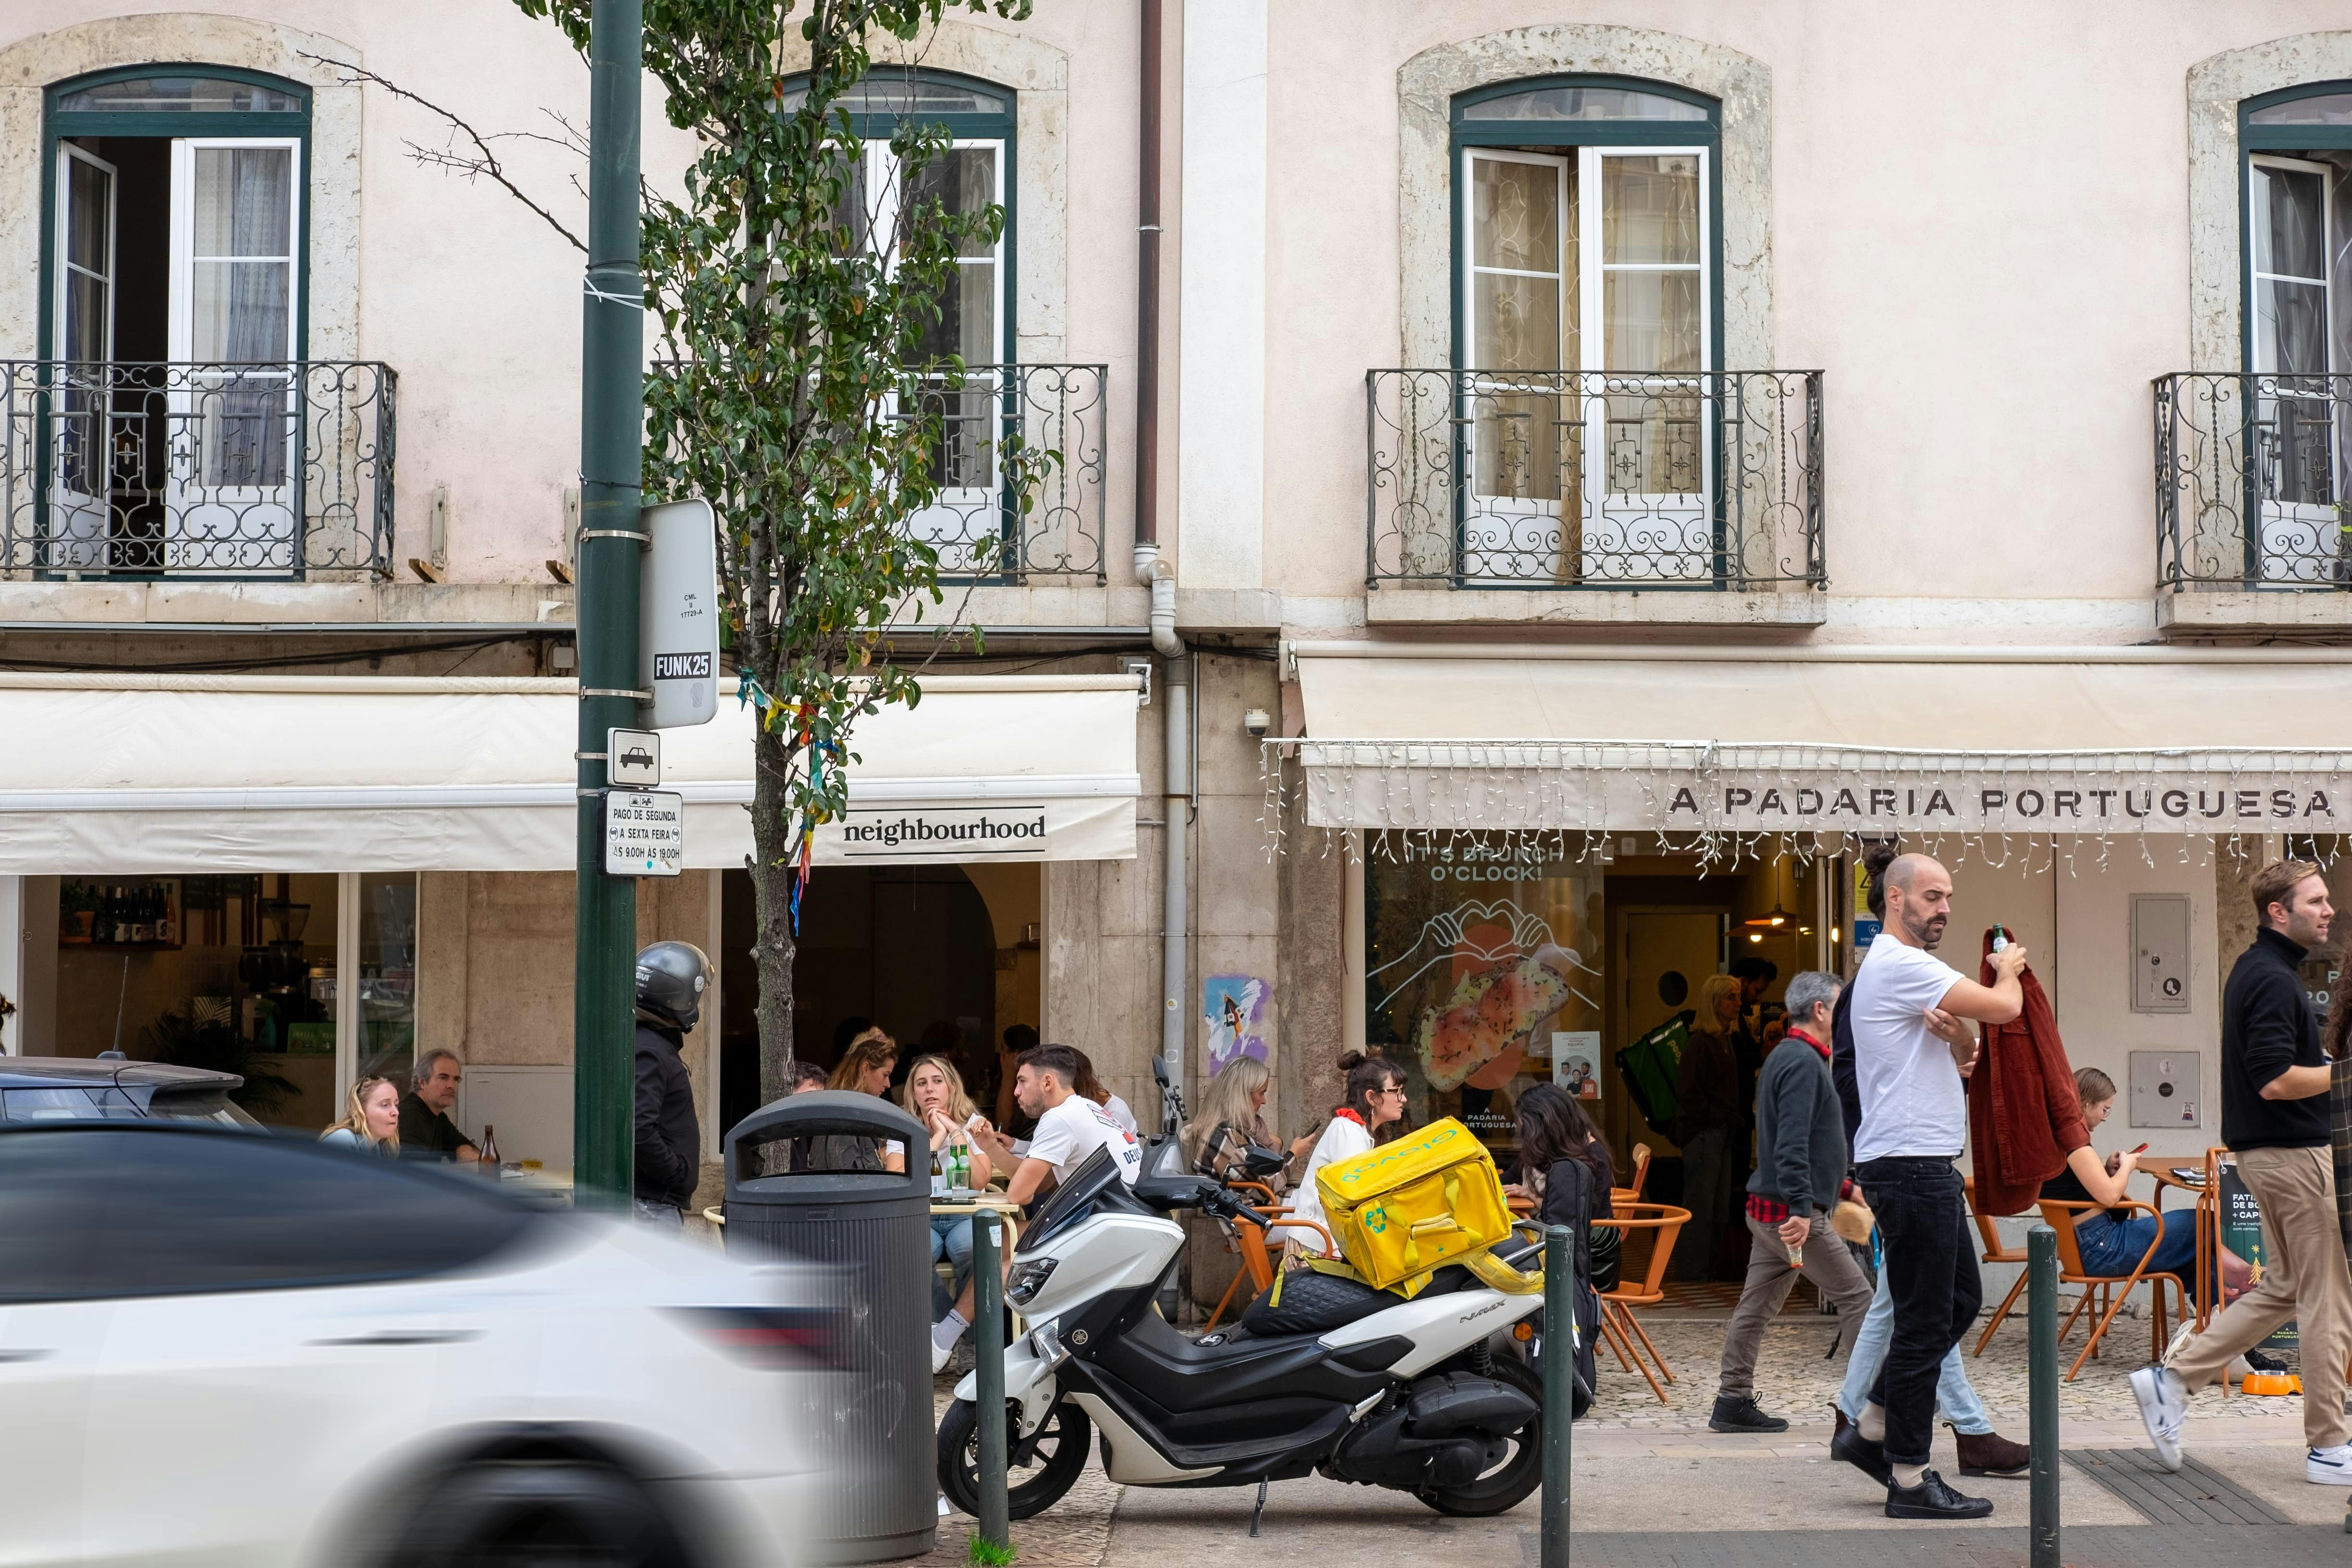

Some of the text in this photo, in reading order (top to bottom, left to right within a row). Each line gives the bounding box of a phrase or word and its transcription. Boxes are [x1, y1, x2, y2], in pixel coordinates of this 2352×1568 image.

[681, 609, 703, 619] 17729-A
[656, 655, 709, 677] FUNK25
[1669, 788, 2336, 818] A PADARIA PORTUGUESA
[613, 809, 676, 821] PAGO DE SEGUNDA
[620, 828, 670, 840] A SEXTA FEIRA
[844, 815, 1046, 846] neighbourhood
[626, 847, 645, 858] 9.00H
[648, 845, 657, 858] ÀS
[660, 847, 680, 859] 19.00H
[1409, 847, 1562, 862] IT'S BRUNCH
[1431, 866, 1542, 881] O'CLOCK!
[1459, 1298, 1507, 1323] NMAX
